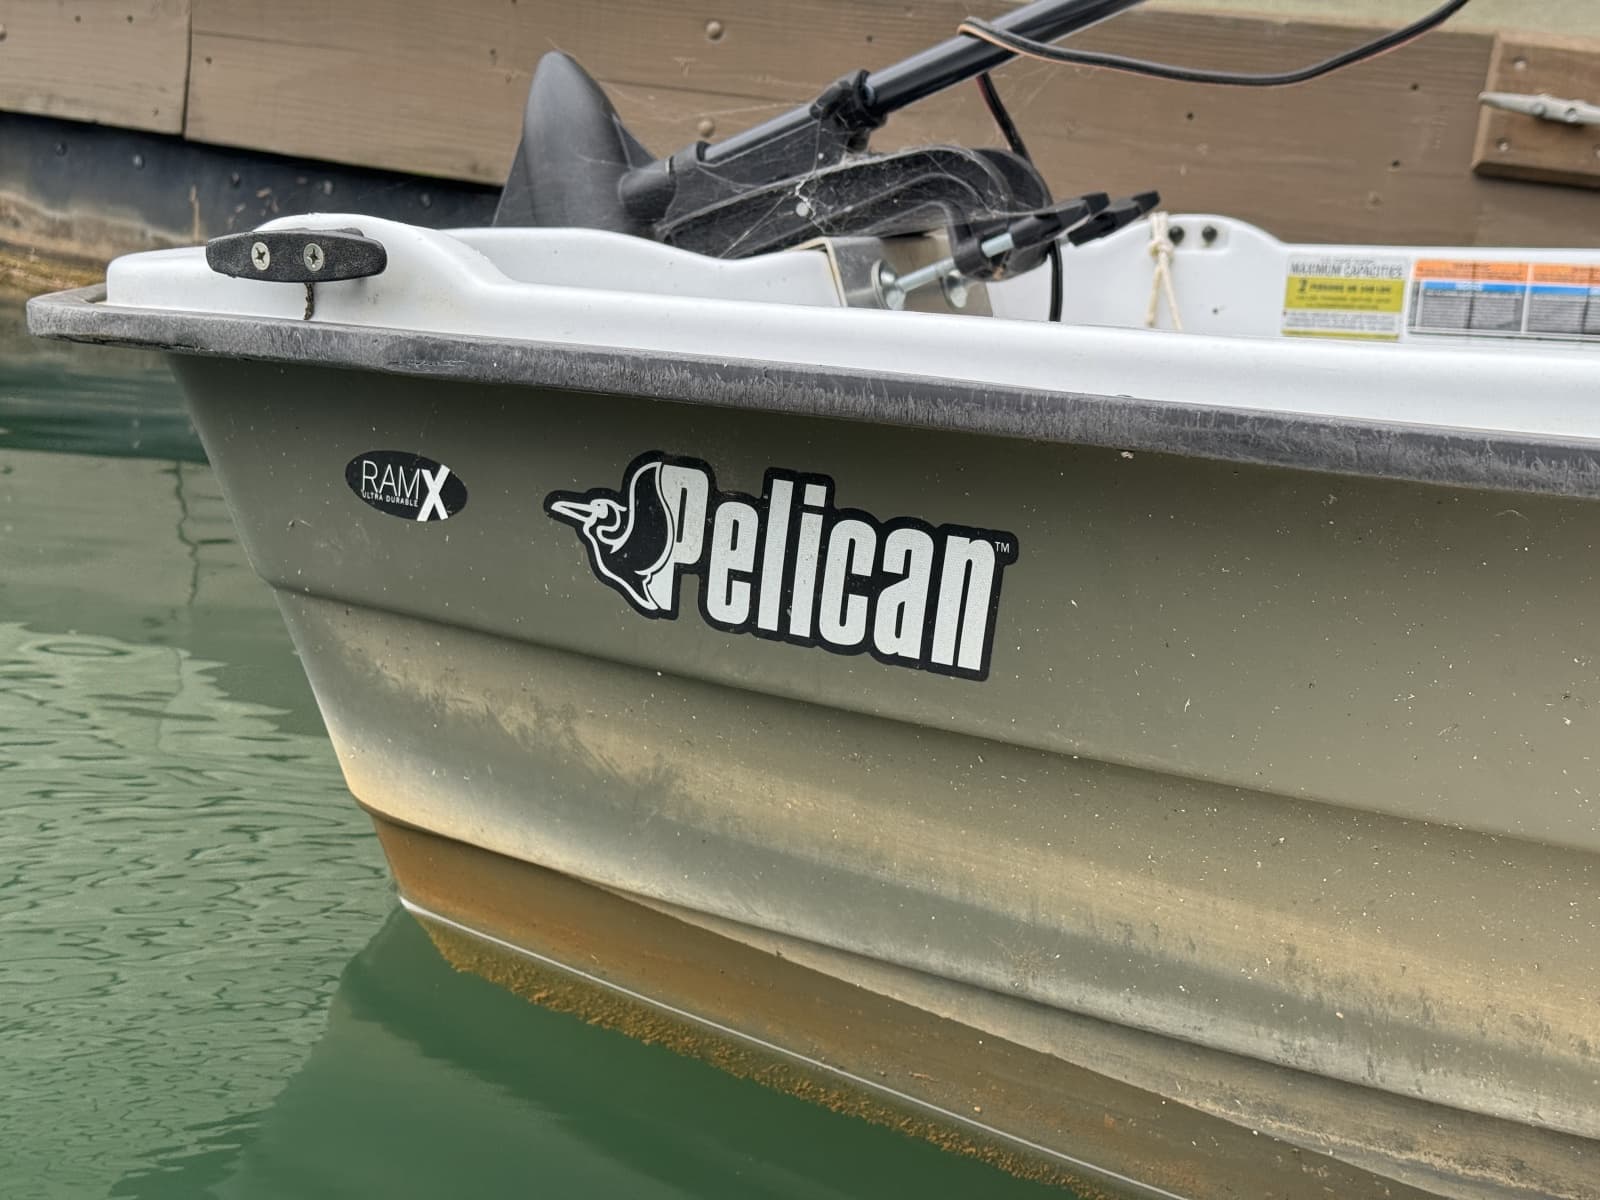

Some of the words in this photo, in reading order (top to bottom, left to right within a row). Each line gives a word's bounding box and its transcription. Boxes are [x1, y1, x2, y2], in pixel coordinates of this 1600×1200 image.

[1290, 262, 1342, 276] MAXIMUM
[1343, 263, 1404, 278] CAPACITIES
[361, 489, 384, 501] ULTRA
[385, 494, 419, 508] DURABLE
[646, 463, 996, 672] Pelican
